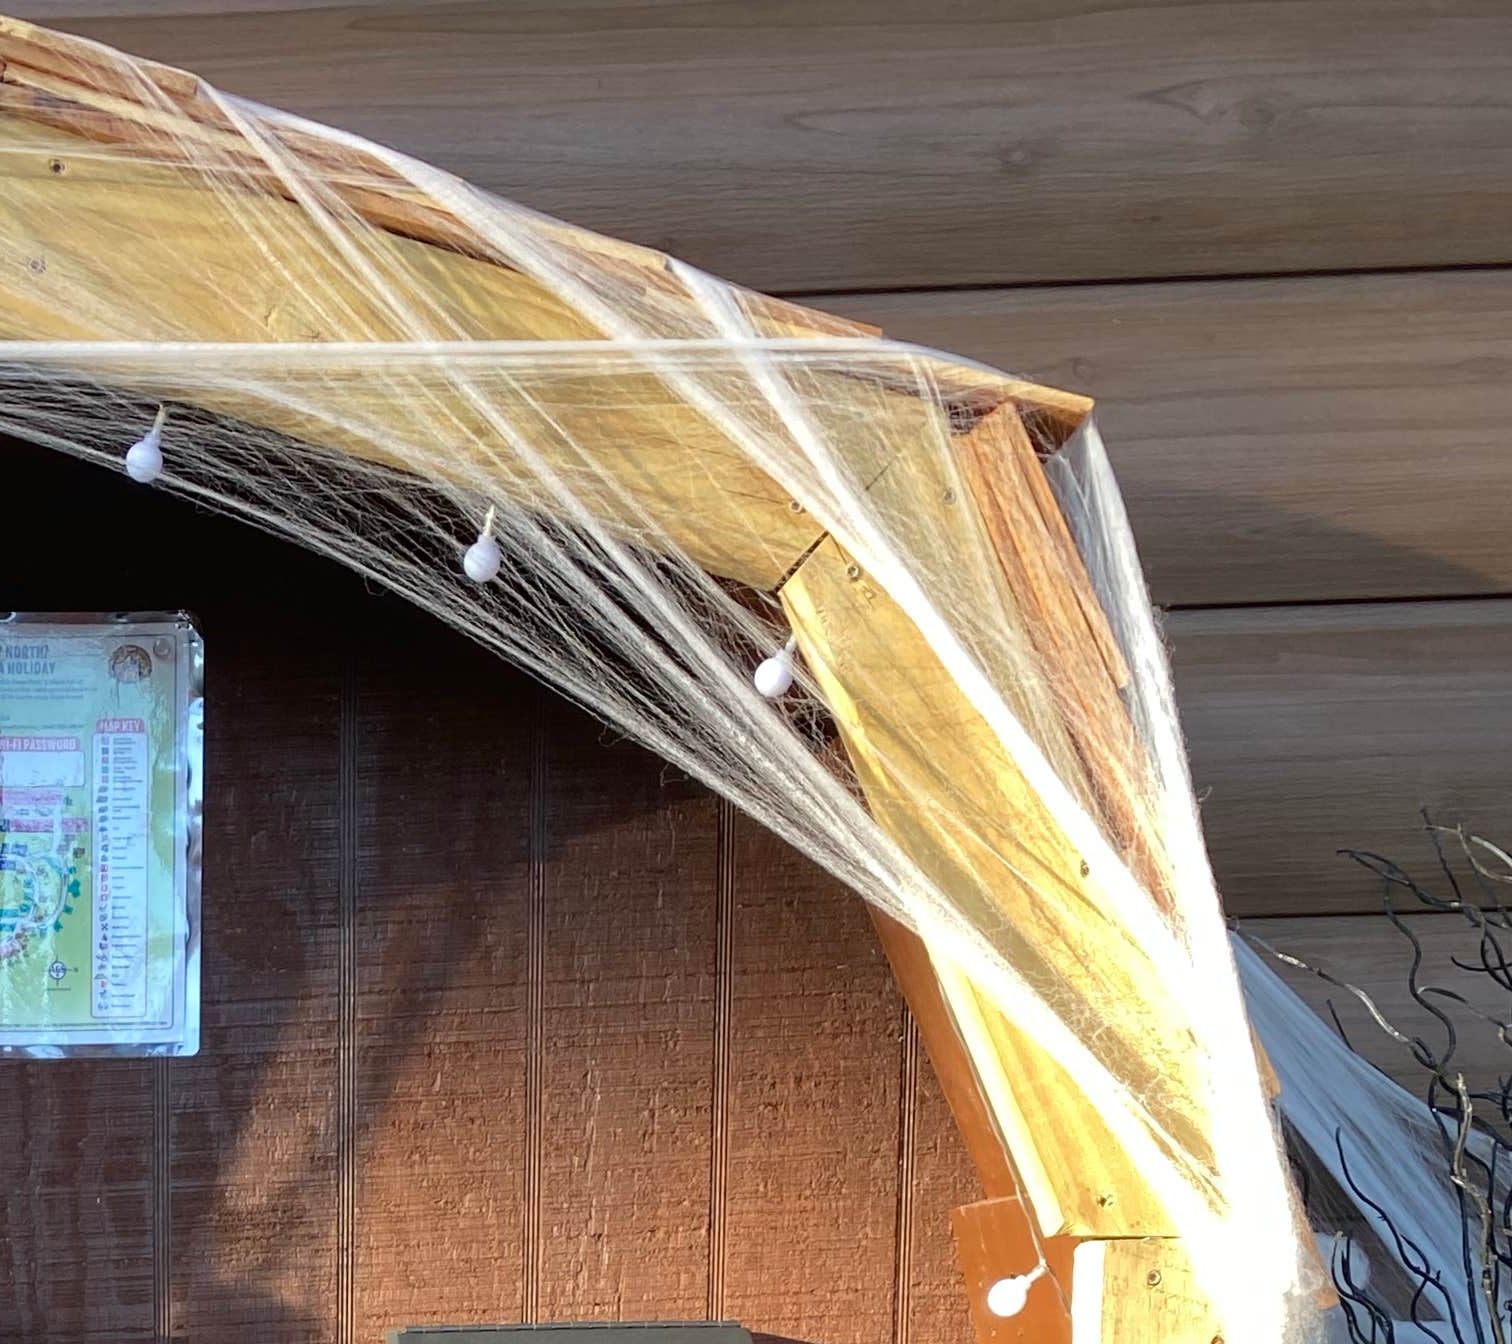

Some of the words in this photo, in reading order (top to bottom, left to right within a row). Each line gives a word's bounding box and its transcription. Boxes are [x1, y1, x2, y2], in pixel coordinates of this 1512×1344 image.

[7, 661, 56, 675] HOLIDAY
[99, 720, 121, 733] MAP
[122, 720, 141, 732] KEY
[23, 738, 77, 750] PASSWORD
